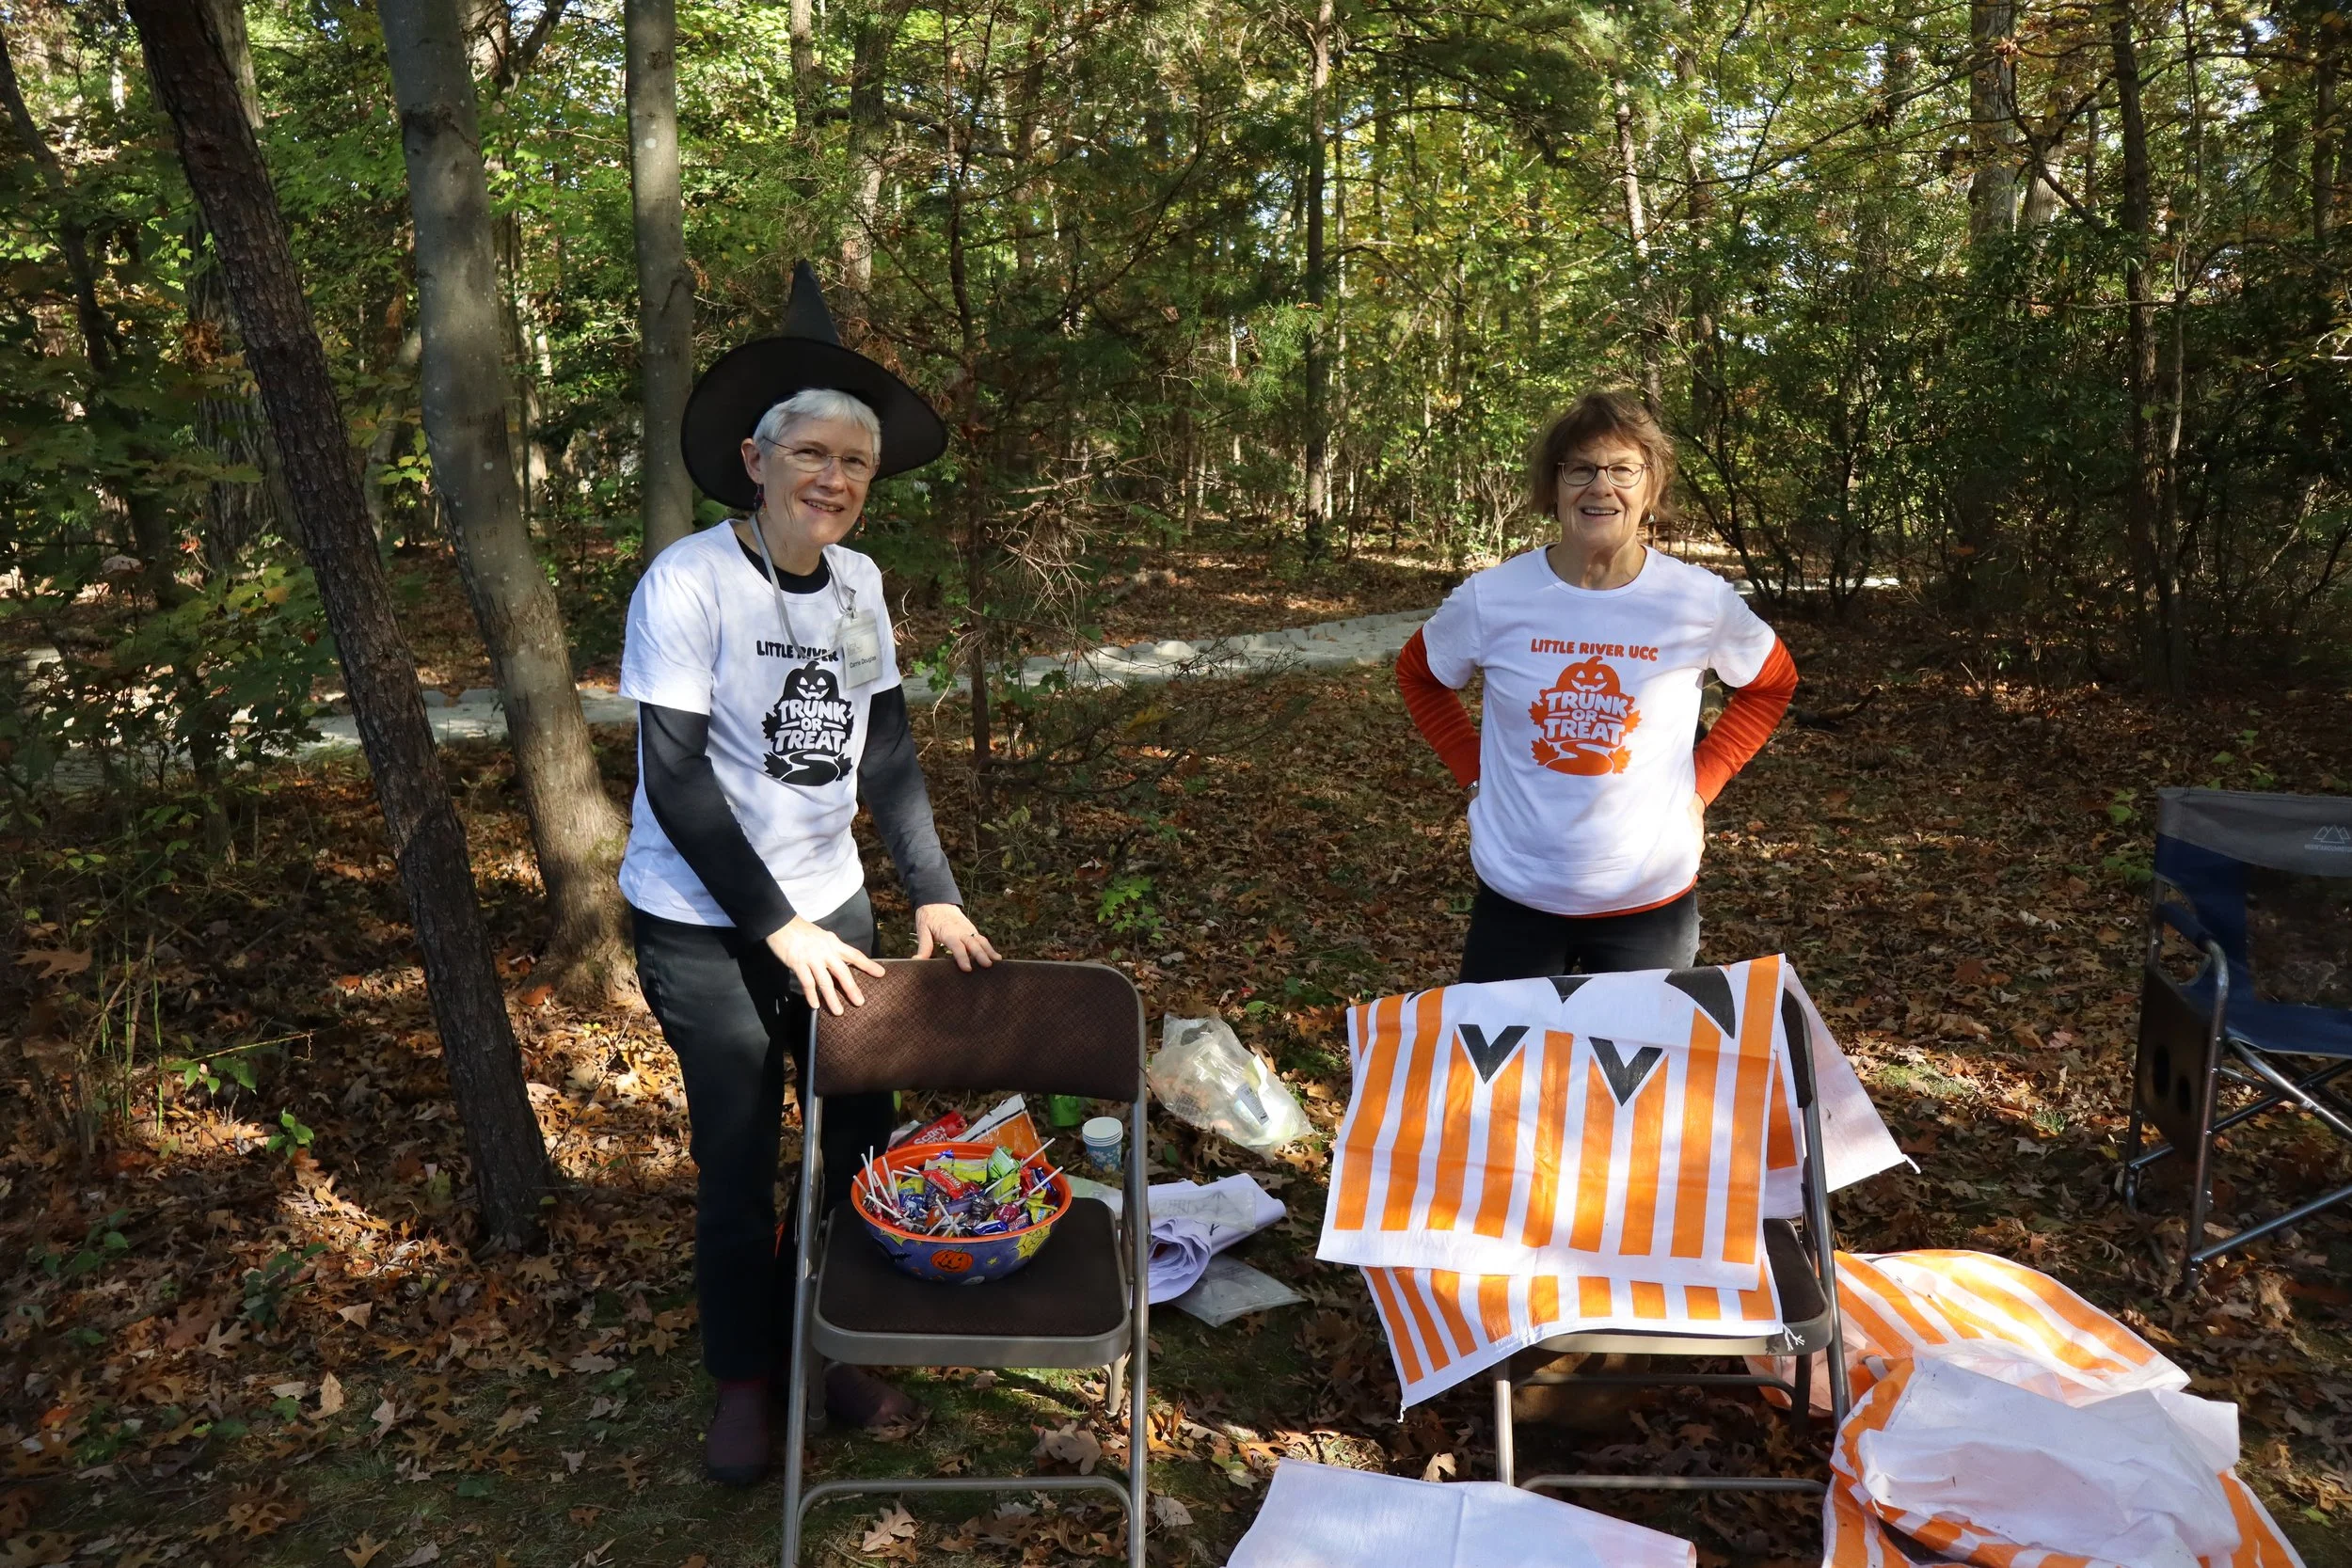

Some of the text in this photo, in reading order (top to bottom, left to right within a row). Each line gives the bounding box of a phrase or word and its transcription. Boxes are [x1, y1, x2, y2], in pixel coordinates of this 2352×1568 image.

[756, 641, 793, 658] LITTLE
[1531, 639, 1659, 661] LITTLE RIVER UCC
[778, 699, 848, 725] TRUNK
[1546, 691, 1628, 718] TRUNK
[1571, 709, 1597, 722] OR
[802, 718, 823, 731] OR
[1544, 719, 1626, 745] TREAT
[774, 731, 847, 753] TREAT
